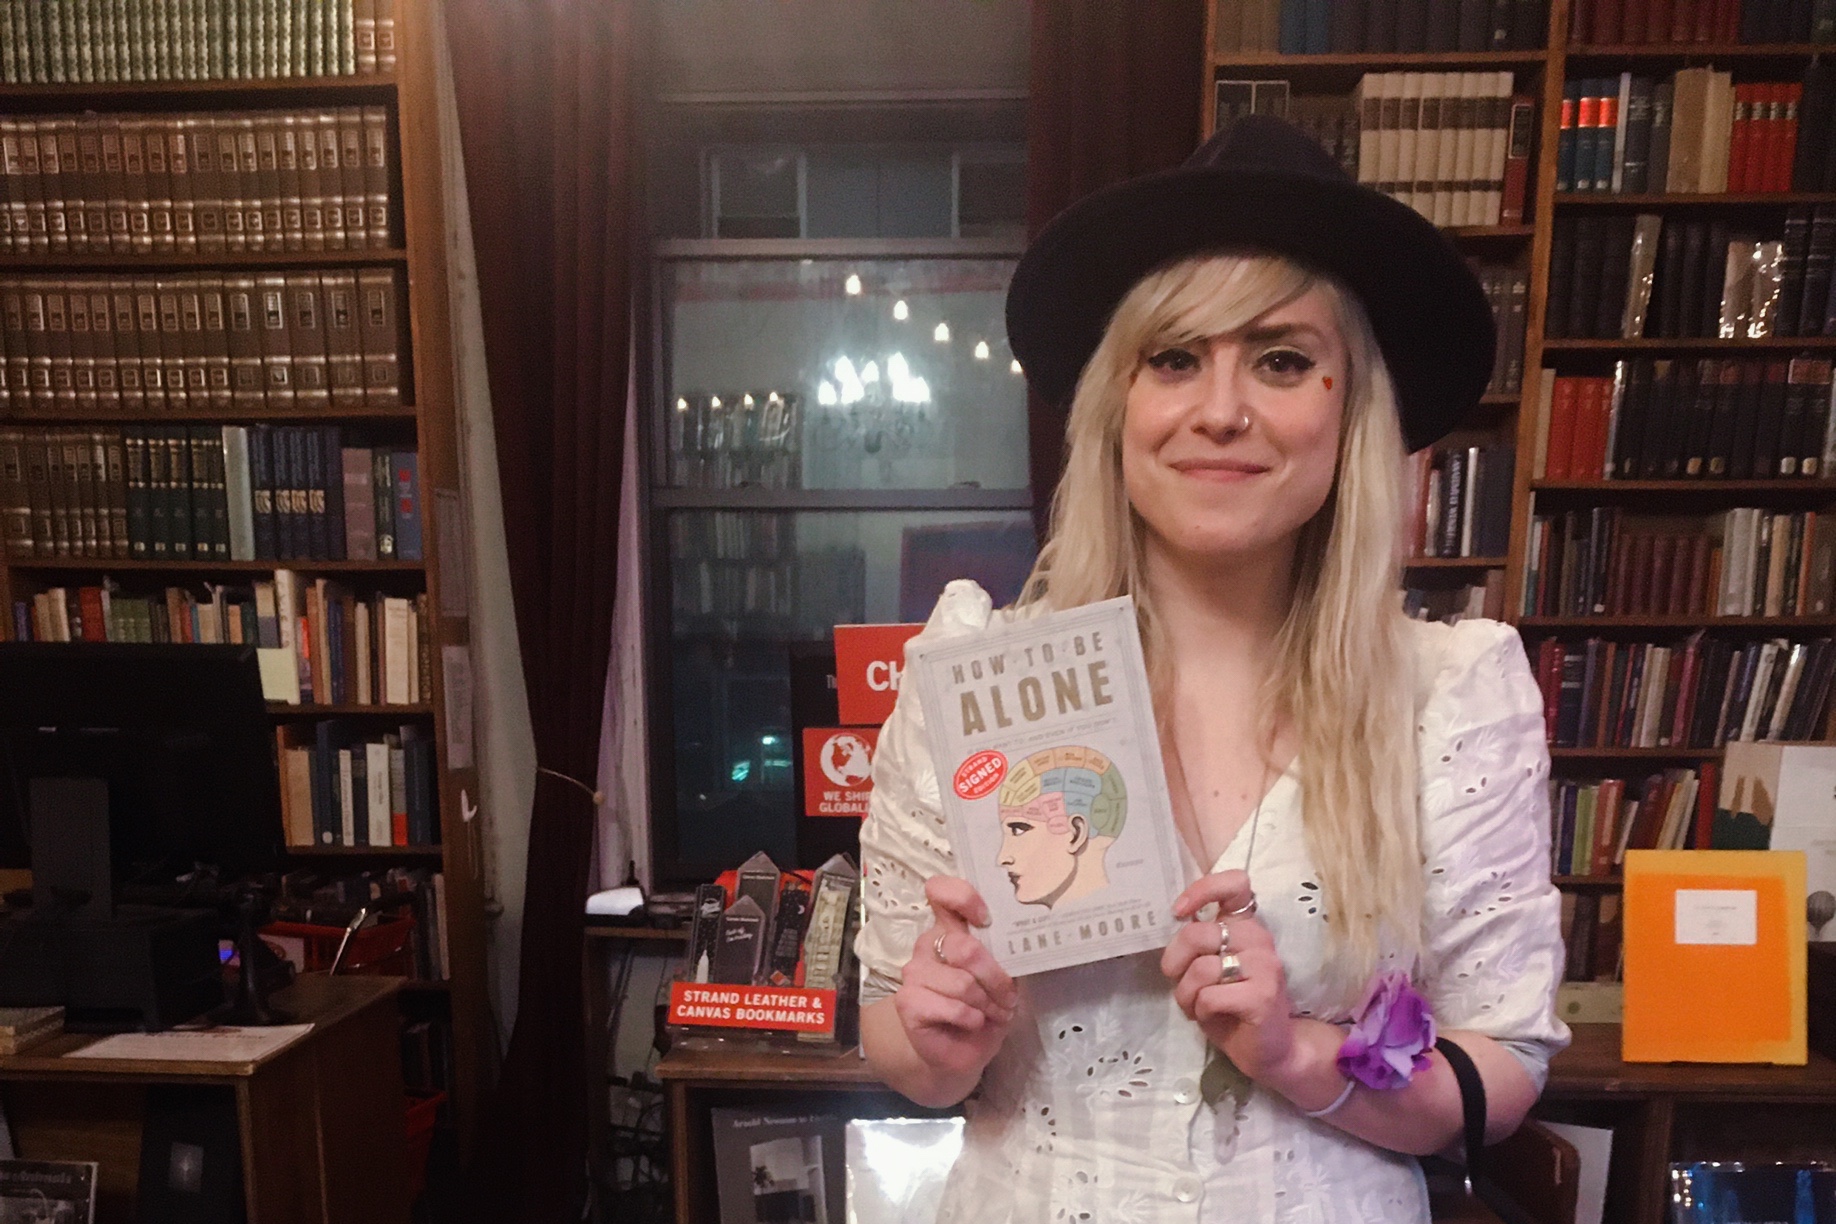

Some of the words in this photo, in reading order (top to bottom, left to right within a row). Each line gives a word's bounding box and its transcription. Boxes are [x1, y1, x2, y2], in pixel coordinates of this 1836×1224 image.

[952, 653, 1007, 686] HOW
[1024, 642, 1055, 668] TO
[1074, 630, 1104, 658] BE
[960, 659, 1114, 737] ALONE
[959, 757, 1002, 793] SIGNED
[823, 791, 841, 801] WE
[1008, 928, 1063, 956] LANE
[1079, 910, 1157, 943] MOORE
[676, 1004, 732, 1020] CANVAS
[735, 1007, 826, 1025] BOOKMARKS
[684, 990, 740, 1005] STRAND
[744, 993, 808, 1009] LEATHER
[812, 997, 823, 1009] &
